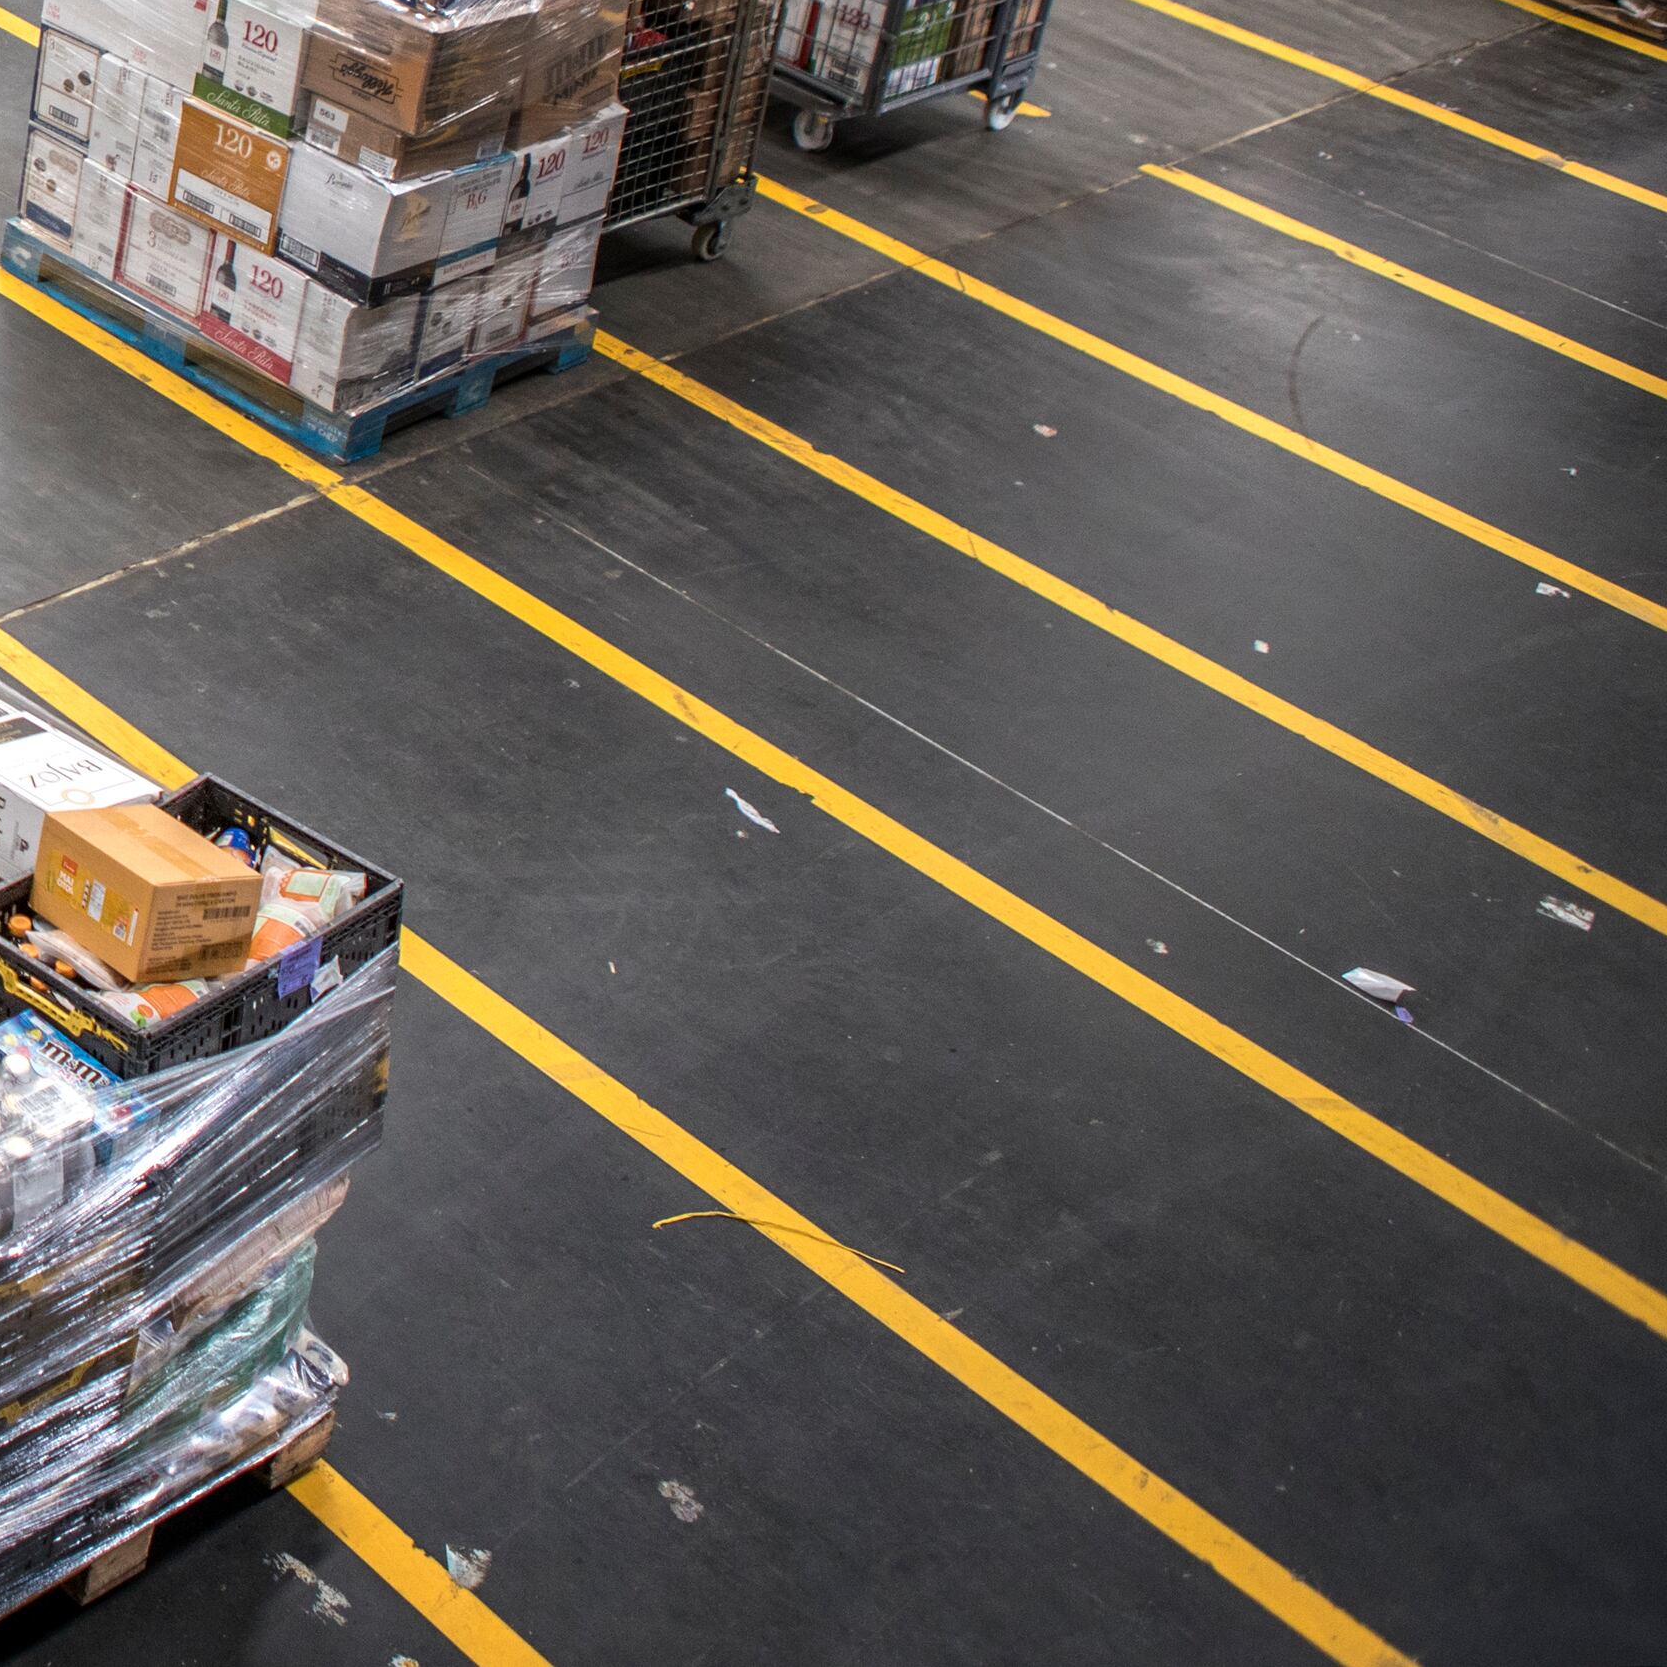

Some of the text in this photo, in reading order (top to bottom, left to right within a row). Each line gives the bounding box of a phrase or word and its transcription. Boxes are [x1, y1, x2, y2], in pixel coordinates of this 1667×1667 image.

[243, 19, 279, 54] 120
[216, 123, 254, 160] 120
[249, 264, 284, 301] 120
